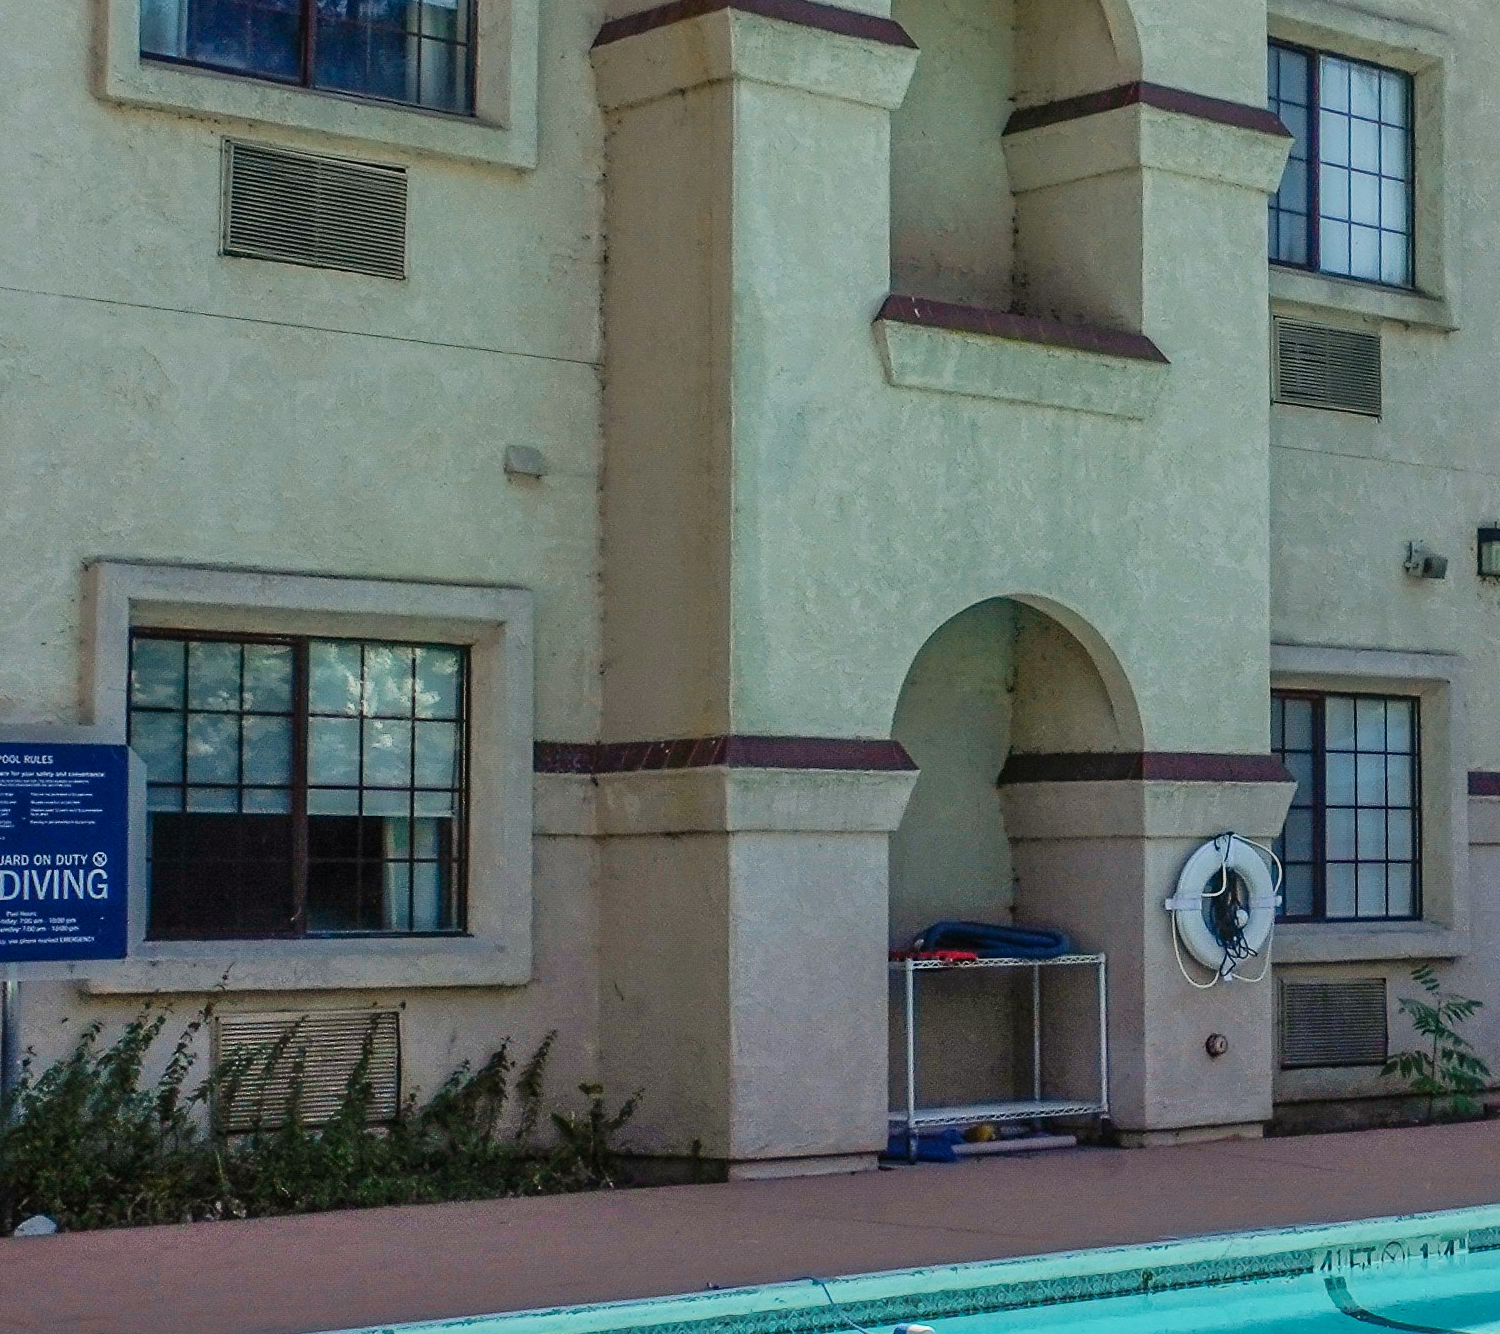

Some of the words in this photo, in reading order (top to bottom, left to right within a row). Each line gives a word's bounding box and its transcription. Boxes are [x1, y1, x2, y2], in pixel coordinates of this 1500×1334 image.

[23, 755, 54, 764] RULES
[33, 854, 52, 865] ON
[55, 854, 88, 865] DUTY
